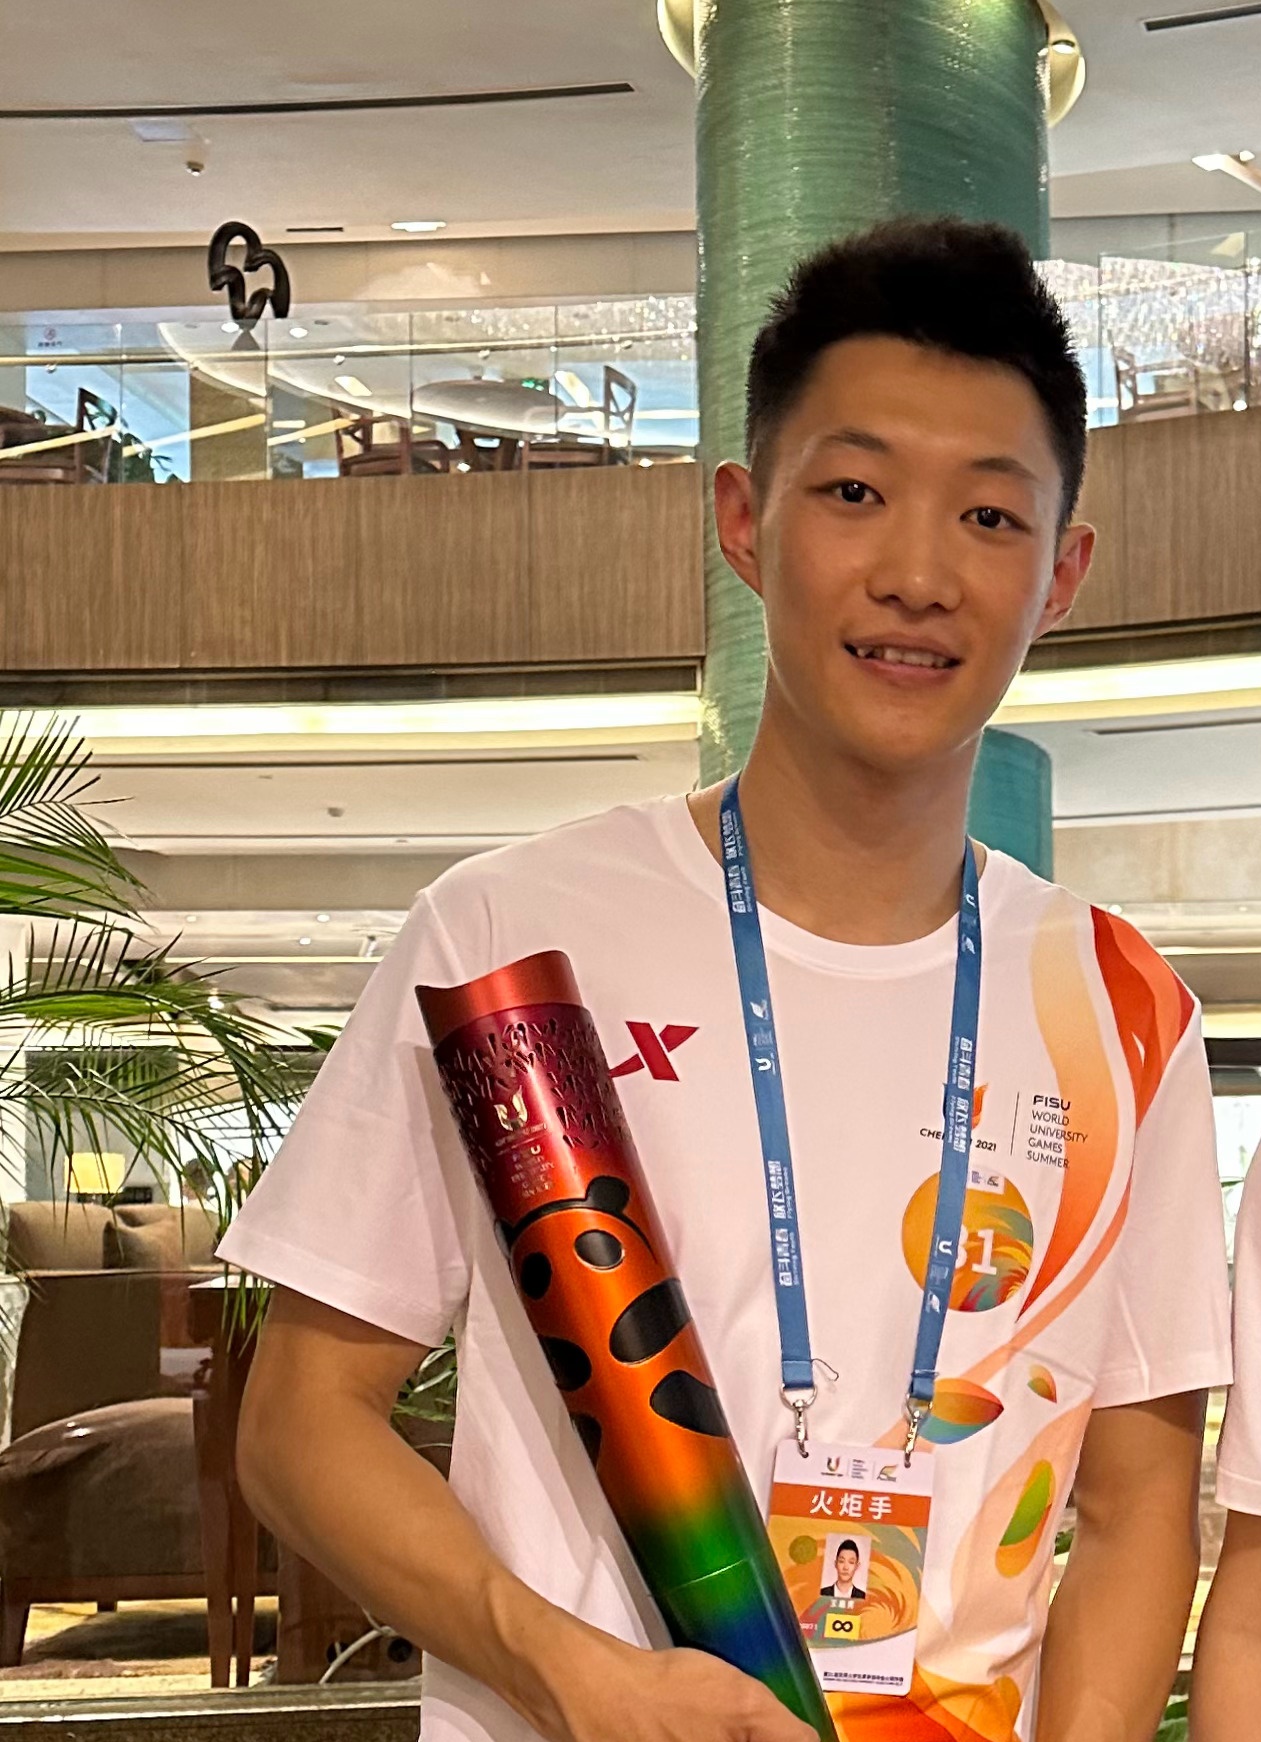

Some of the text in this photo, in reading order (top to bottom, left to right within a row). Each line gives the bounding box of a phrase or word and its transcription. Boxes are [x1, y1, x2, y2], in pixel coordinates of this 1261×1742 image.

[1033, 1095, 1071, 1111] FISU
[1032, 1110, 1069, 1126] WORLD
[1030, 1125, 1089, 1143] UNIVERSITY
[975, 1139, 996, 1152] 2021
[1028, 1137, 1063, 1153] GAMES
[1026, 1150, 1070, 1169] SUMMER
[810, 1490, 892, 1520] 火炬手
